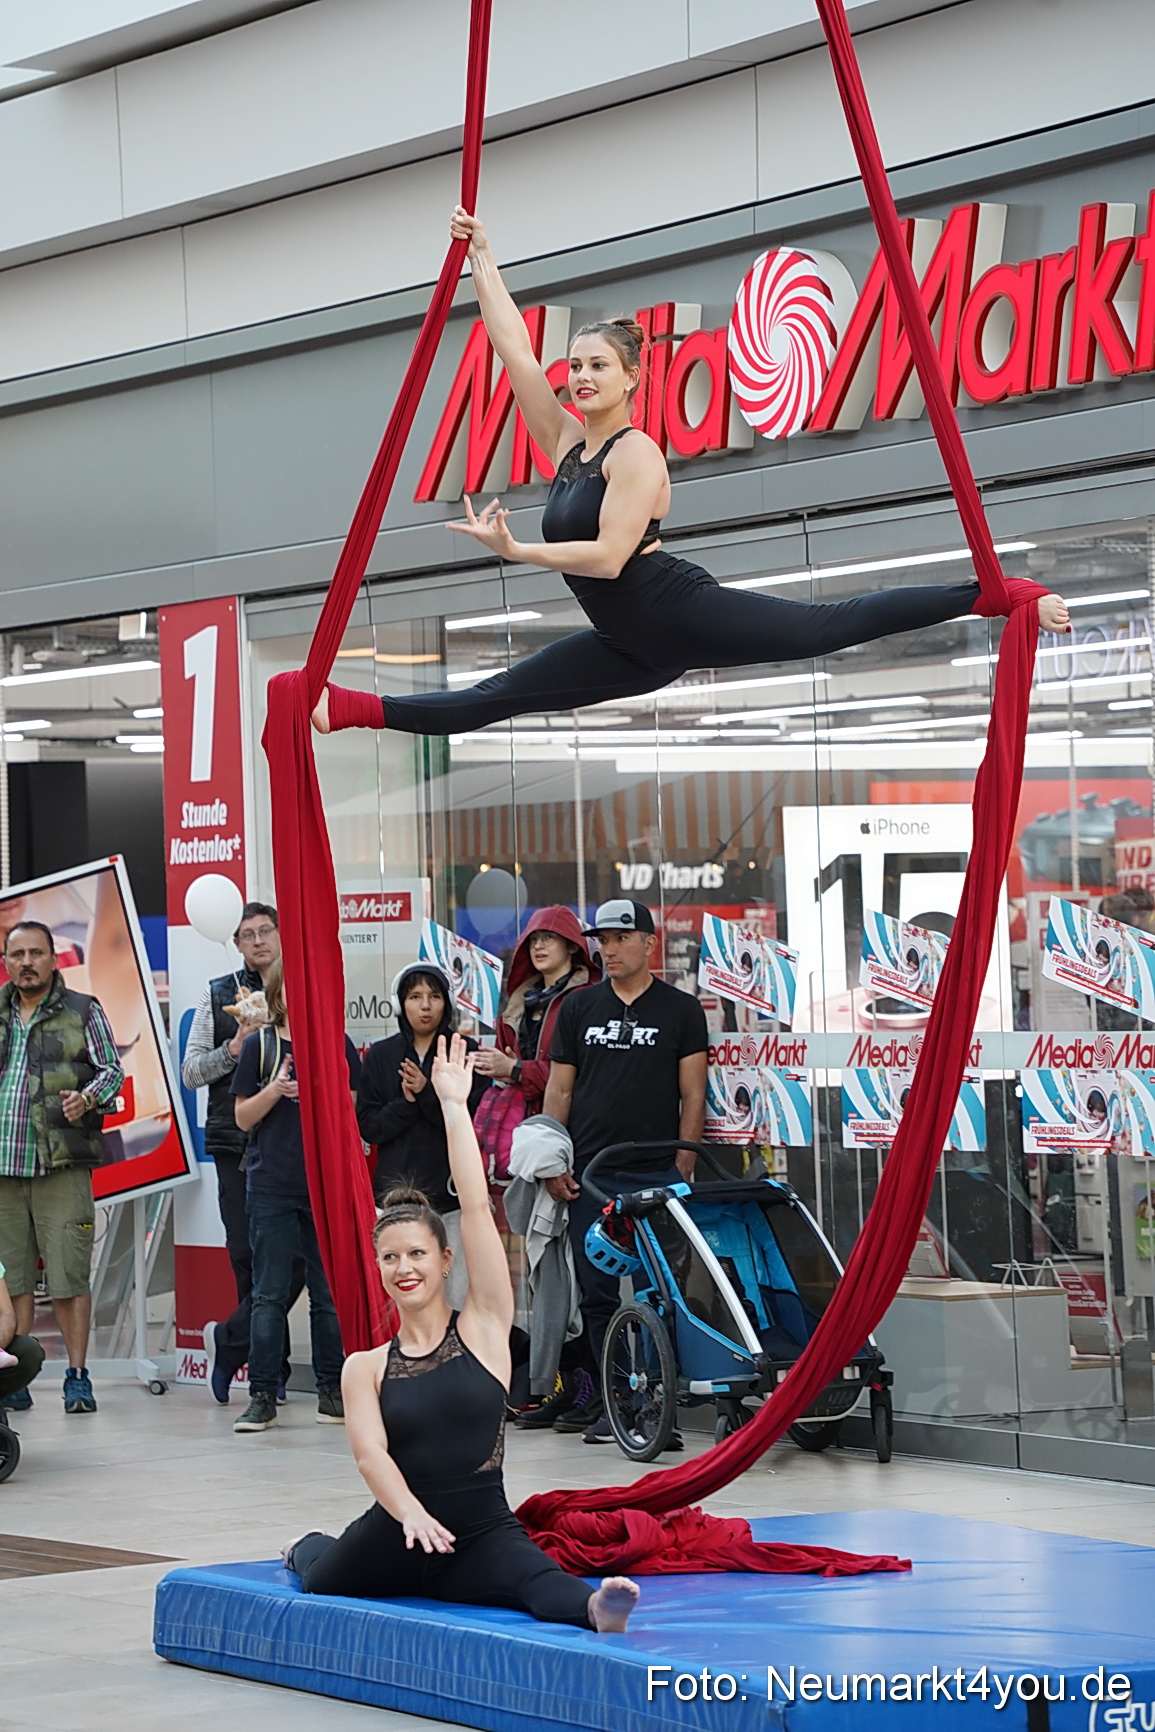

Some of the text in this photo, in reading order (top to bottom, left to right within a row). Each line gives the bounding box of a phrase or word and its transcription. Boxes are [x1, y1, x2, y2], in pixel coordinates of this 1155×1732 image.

[183, 625, 218, 782] 1
[181, 798, 227, 829] Stunde
[873, 818, 931, 836] iPhone
[356, 898, 402, 918] Markt
[584, 1027, 659, 1040] PLAET
[706, 1035, 807, 1067] edia Markt
[846, 1035, 909, 1068] Media
[1025, 1034, 1095, 1069] Media
[177, 1353, 208, 1379] Med
